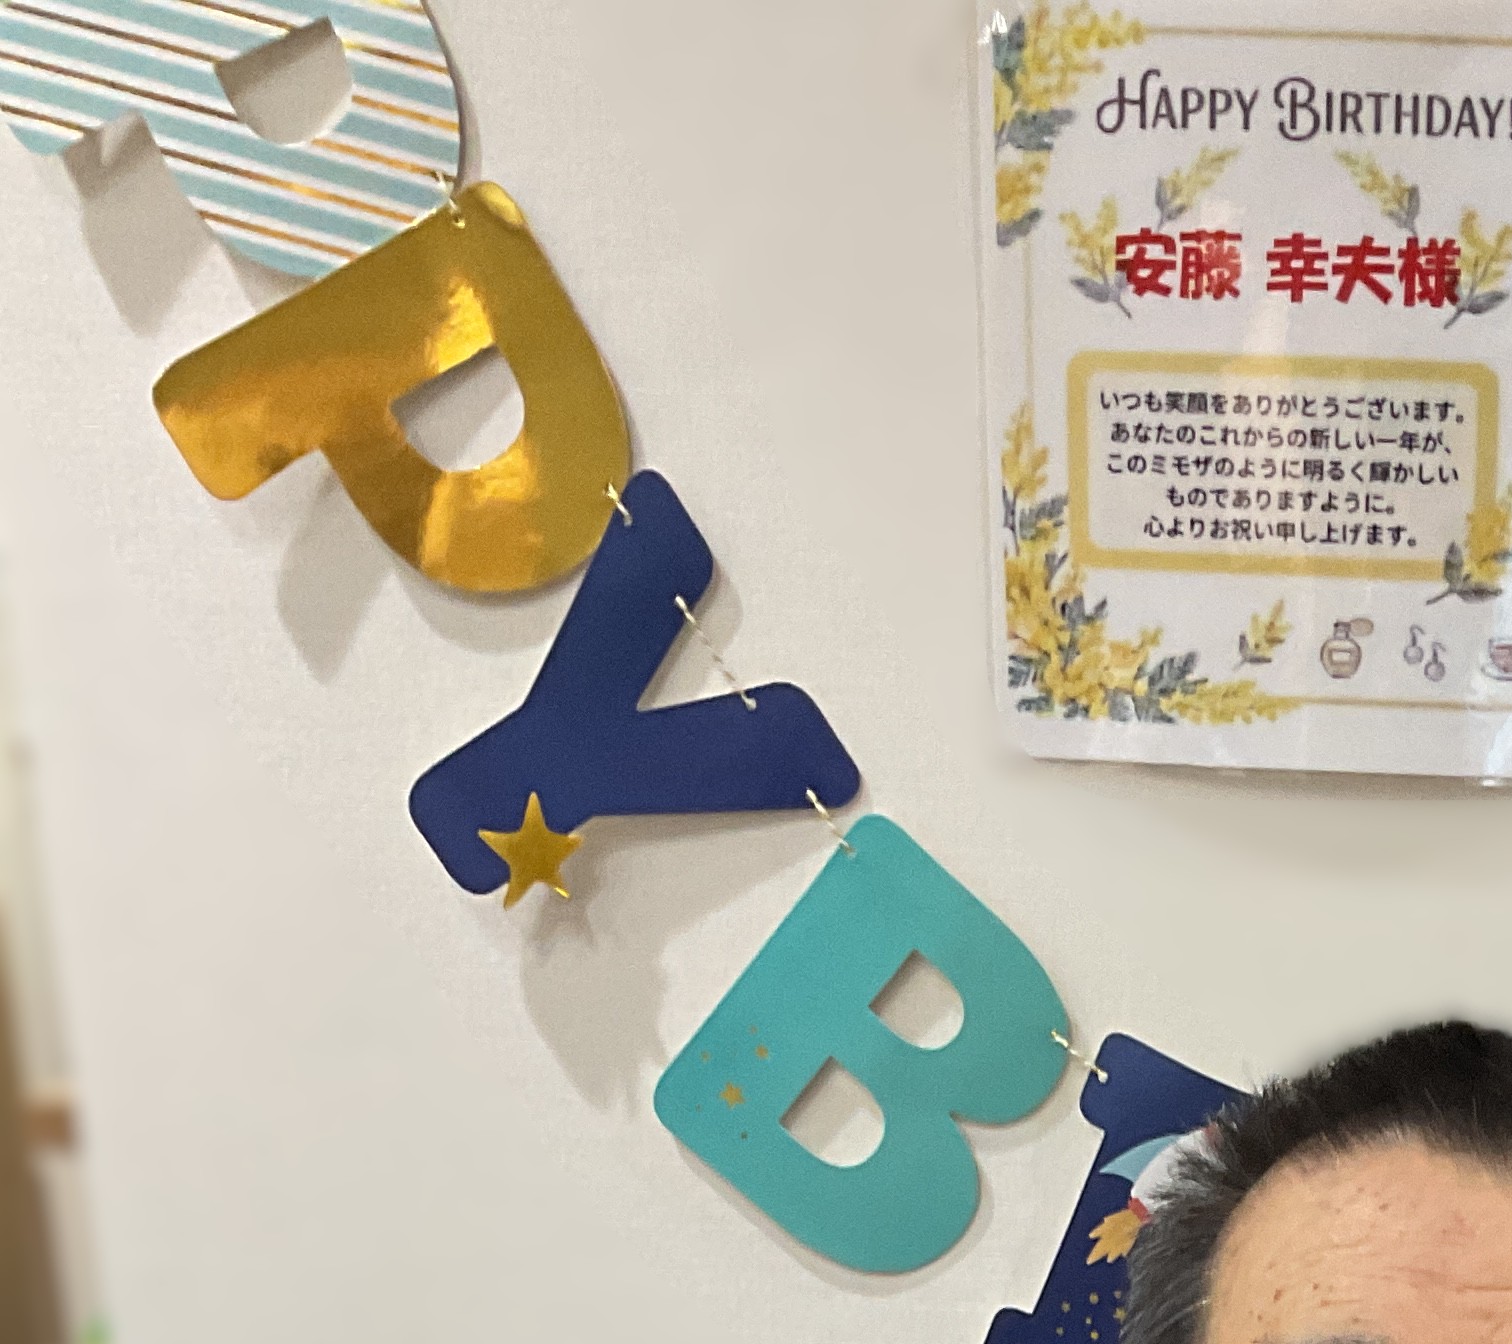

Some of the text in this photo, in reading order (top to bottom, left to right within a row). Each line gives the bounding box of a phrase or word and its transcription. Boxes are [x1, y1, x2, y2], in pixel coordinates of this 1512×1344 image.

[1096, 69, 1259, 133] HAPPY
[1115, 227, 1461, 308] 安藤 幸夫様
[1100, 390, 1465, 424] いつも笑顔をありがとうございます。
[1110, 423, 1452, 454] あなたのこれからの新しい一年が、
[1107, 454, 1459, 486] このミモザのように明るく輝かしい
[1166, 486, 1395, 515] ものでありますように。
[1143, 515, 1417, 548] 心よりお祝い申し上げます。
